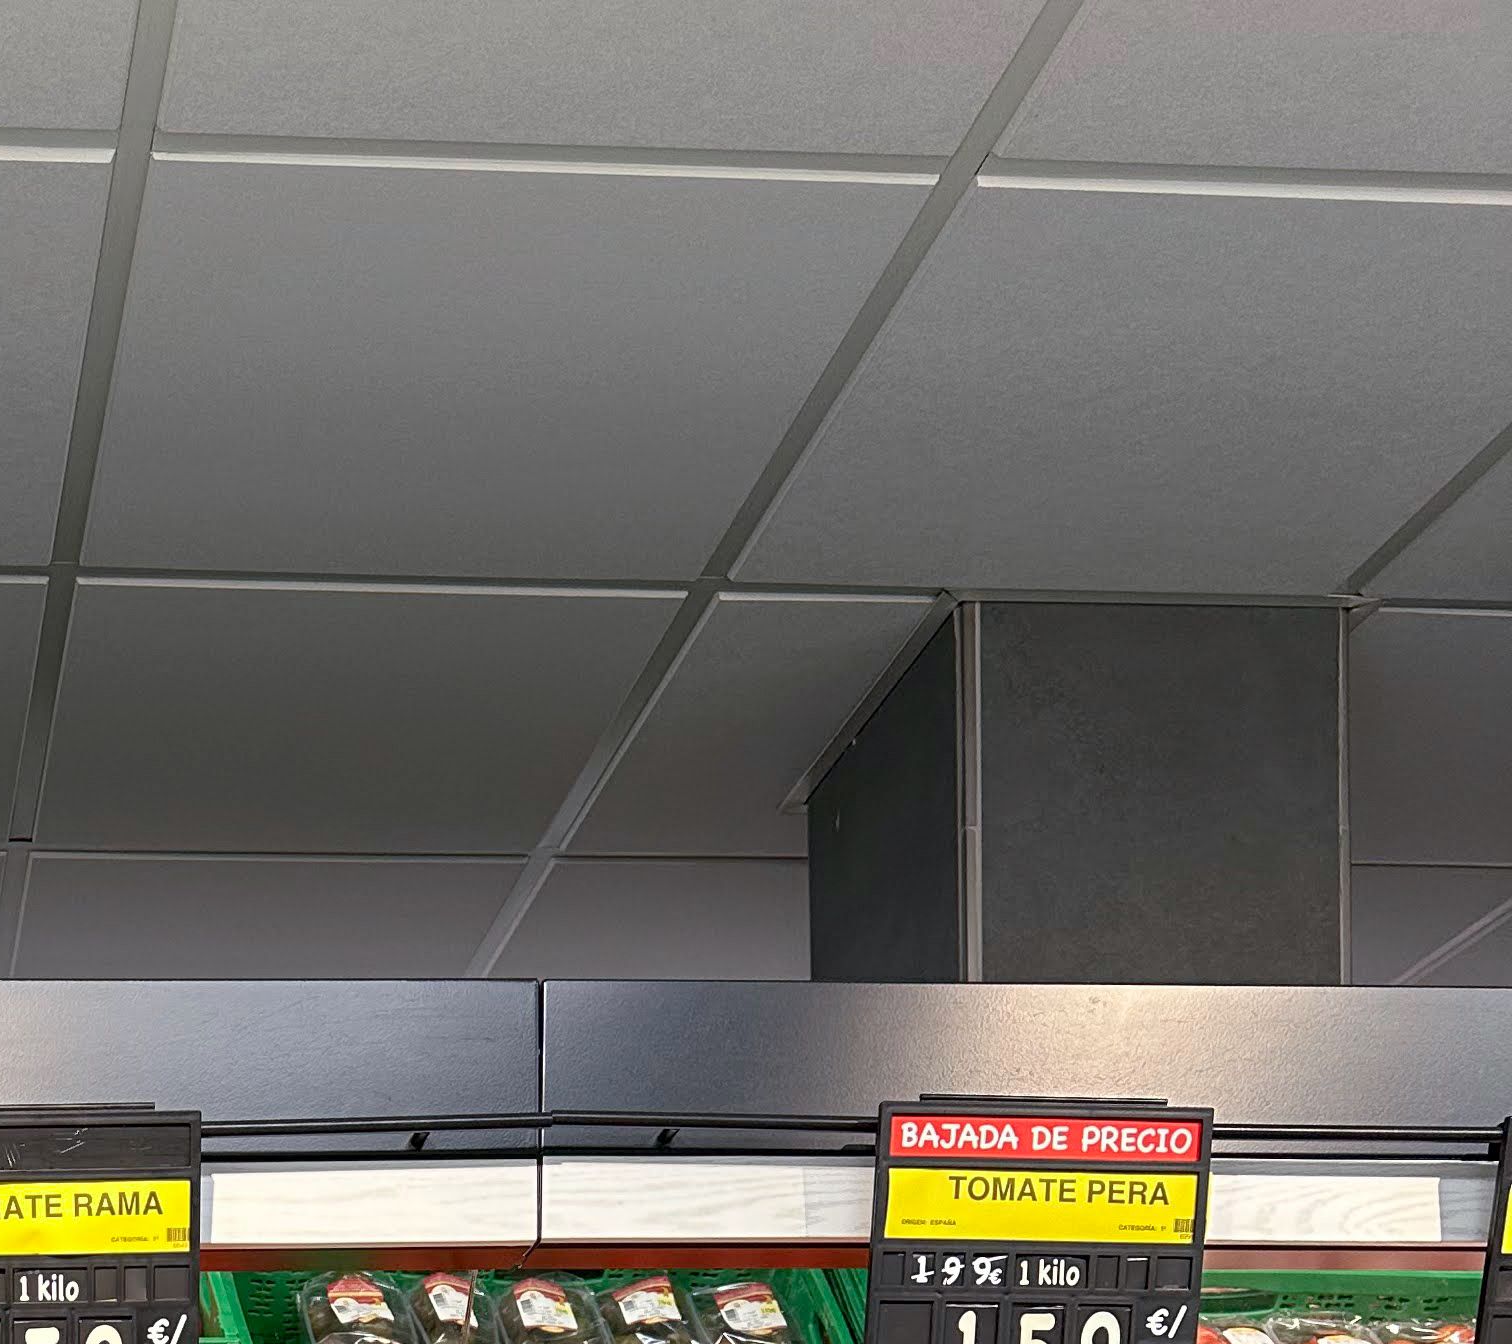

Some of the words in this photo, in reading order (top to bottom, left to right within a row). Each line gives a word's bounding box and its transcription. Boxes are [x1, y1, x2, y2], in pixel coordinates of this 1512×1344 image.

[900, 1122, 1019, 1150] BAJADA
[1031, 1125, 1069, 1150] DE
[1081, 1126, 1193, 1155] PRECIO
[73, 1190, 163, 1218] RAMA
[948, 1175, 1077, 1203] TOMATE
[1087, 1178, 1169, 1206] PERA
[1019, 1261, 1029, 1286] 1
[1038, 1259, 1080, 1286] kilo
[19, 1275, 29, 1301] 1
[37, 1274, 79, 1302] kilo
